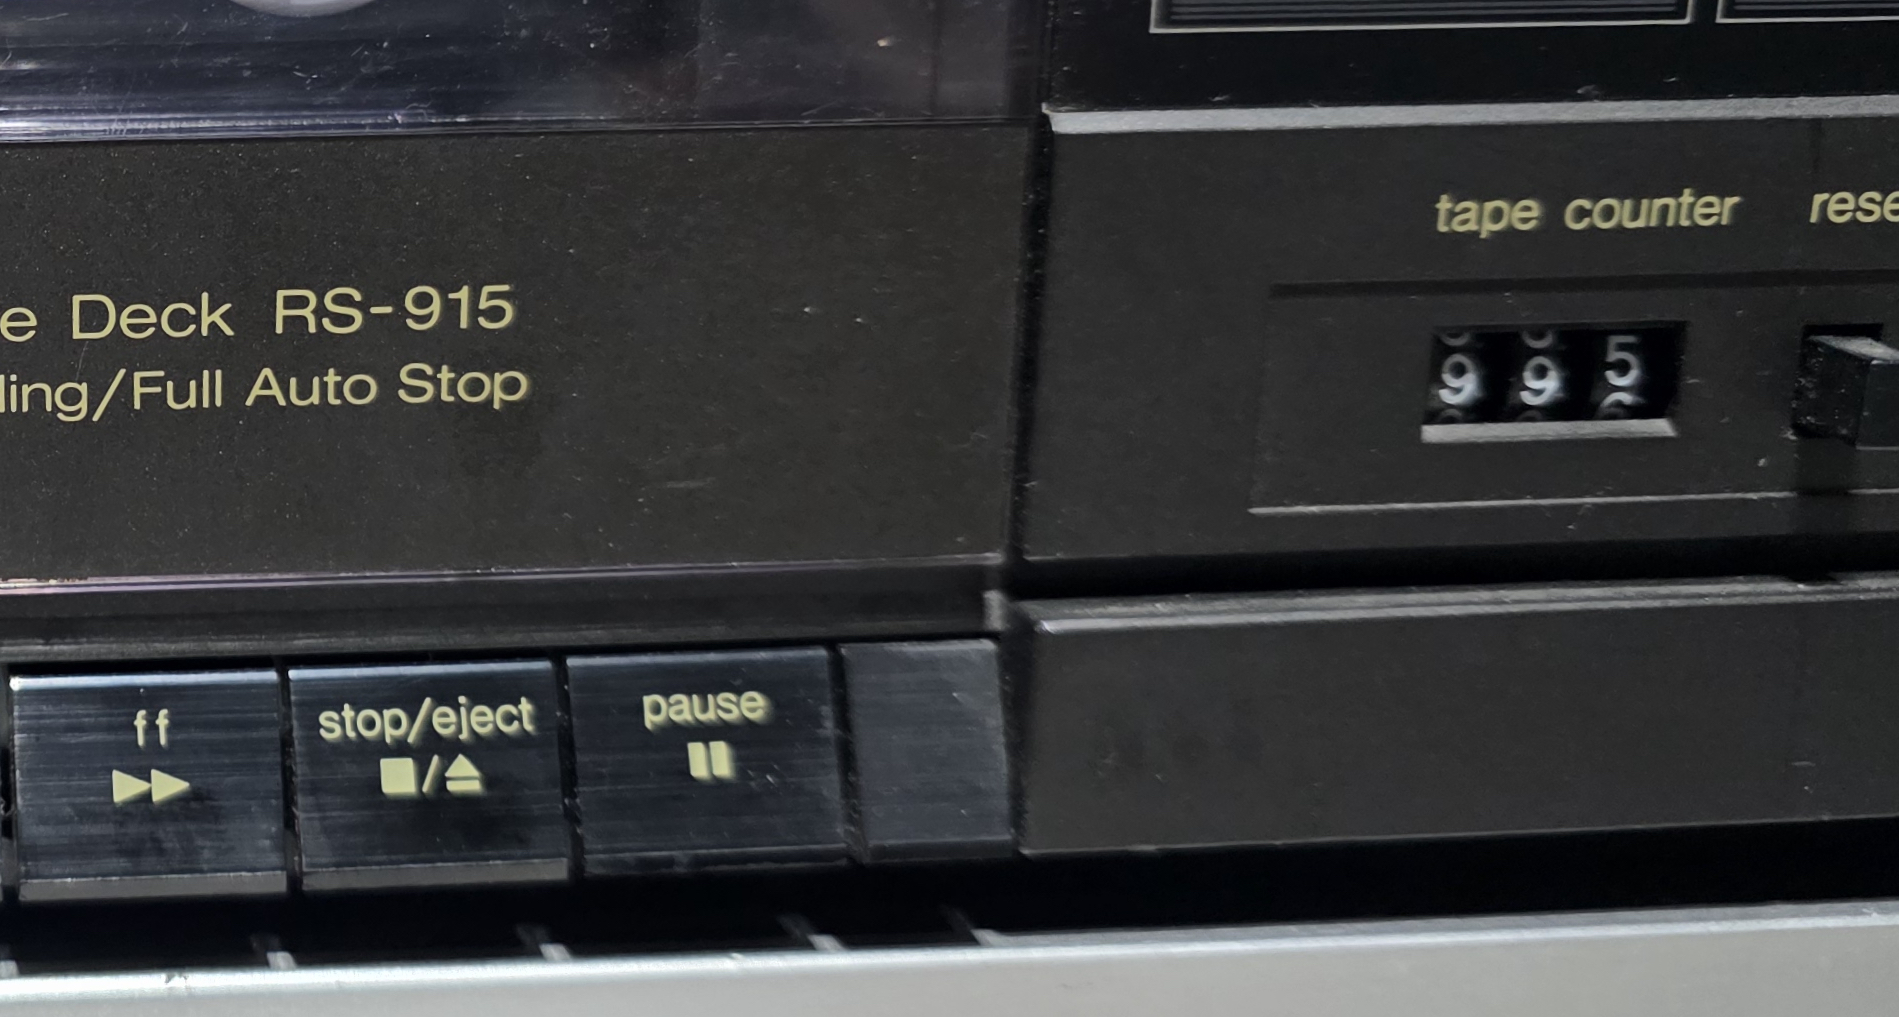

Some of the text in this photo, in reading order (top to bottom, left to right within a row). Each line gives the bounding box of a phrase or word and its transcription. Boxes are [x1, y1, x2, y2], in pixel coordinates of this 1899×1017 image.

[1435, 188, 1742, 239] tape counter
[72, 291, 235, 340] Deck
[275, 284, 514, 335] RS-915
[245, 367, 378, 407] Auto
[397, 362, 529, 407] Stop
[133, 708, 170, 747] ff
[318, 695, 535, 745] stop/eject
[642, 690, 769, 731] pause
